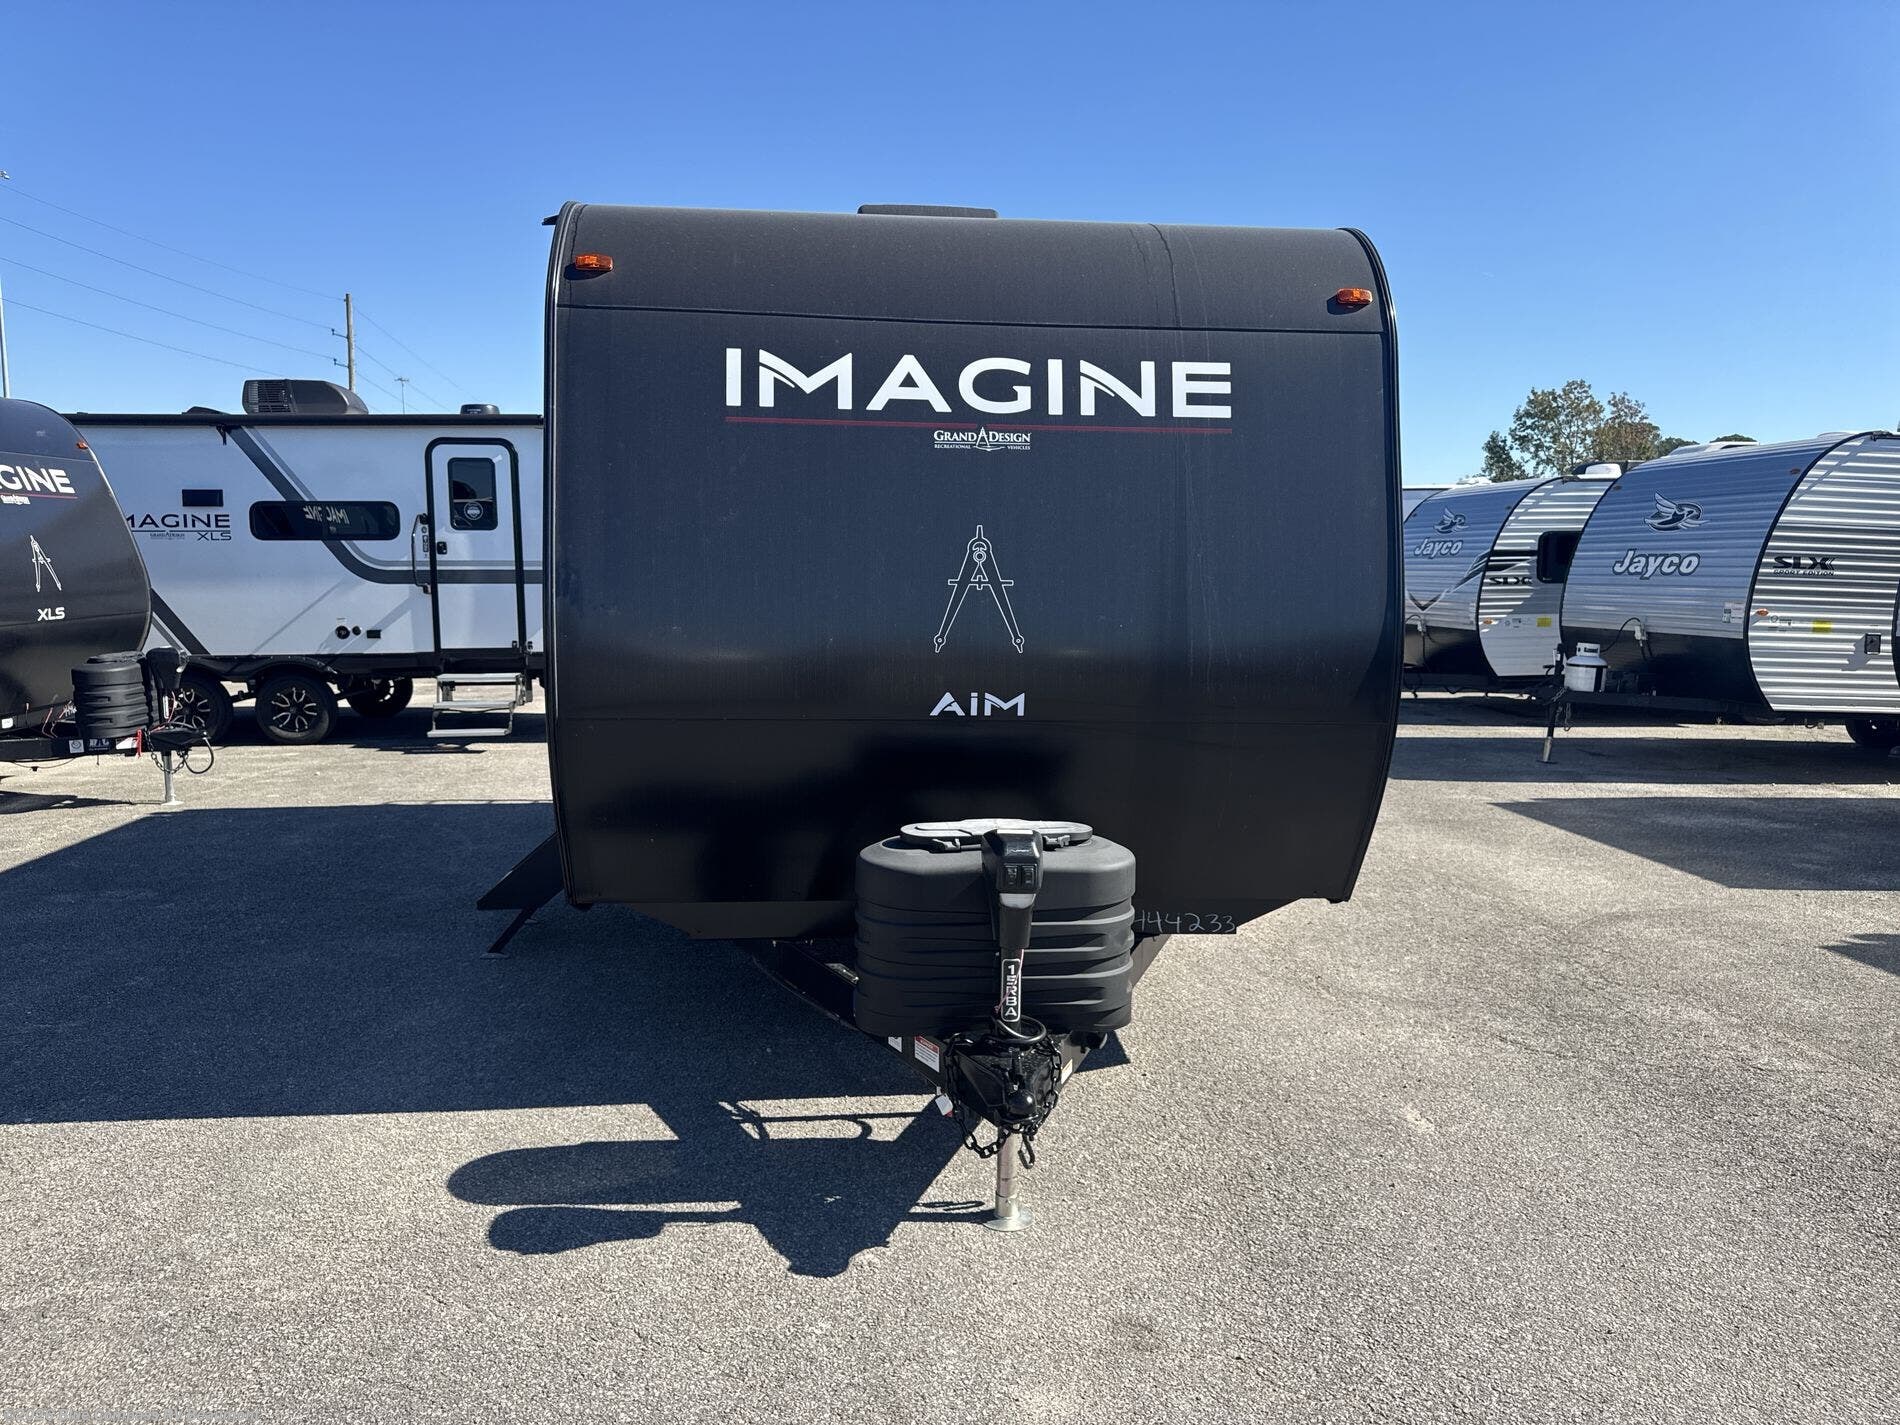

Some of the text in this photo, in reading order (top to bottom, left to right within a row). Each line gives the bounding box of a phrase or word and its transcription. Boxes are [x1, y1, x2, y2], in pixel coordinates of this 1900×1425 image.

[725, 347, 1232, 418] IMAGINE
[0, 464, 76, 494] GINE
[197, 532, 232, 541] XLS
[1414, 537, 1463, 559] Jayco
[1613, 548, 1700, 580] Jayco
[37, 606, 66, 621] XLS
